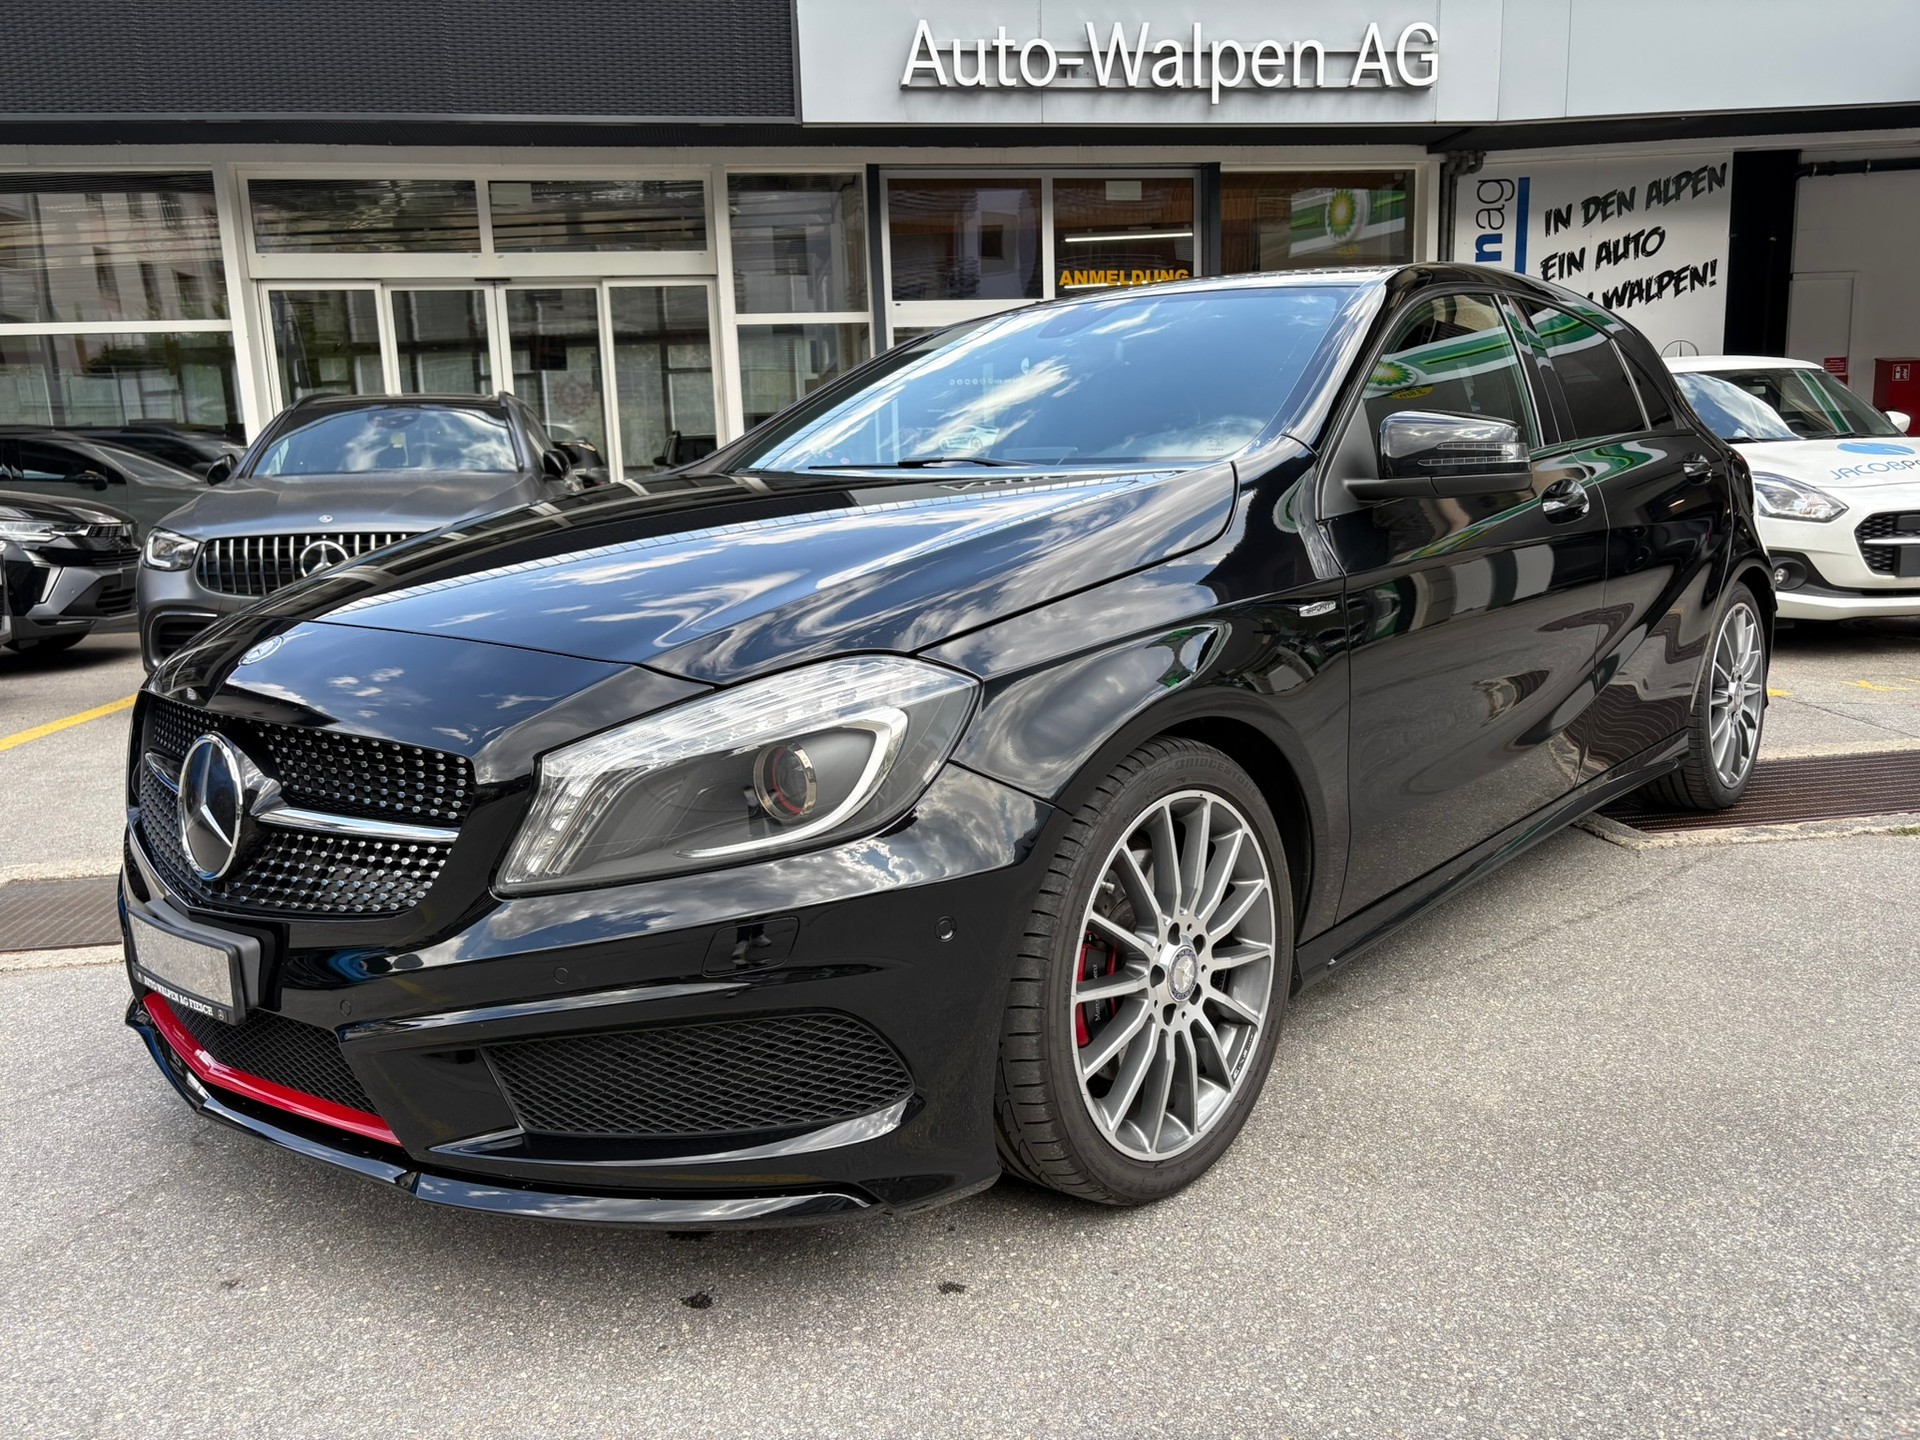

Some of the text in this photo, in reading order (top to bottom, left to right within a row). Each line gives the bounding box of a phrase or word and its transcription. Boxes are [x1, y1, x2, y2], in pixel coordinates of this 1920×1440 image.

[900, 20, 1440, 104] Auto-Walpen AG
[1544, 162, 1727, 237] IN DEN ALPEN
[1059, 269, 1190, 286] ANMELDUNG
[1540, 226, 1666, 283] EIN AUTO
[1602, 259, 1717, 310] WALPEN!
